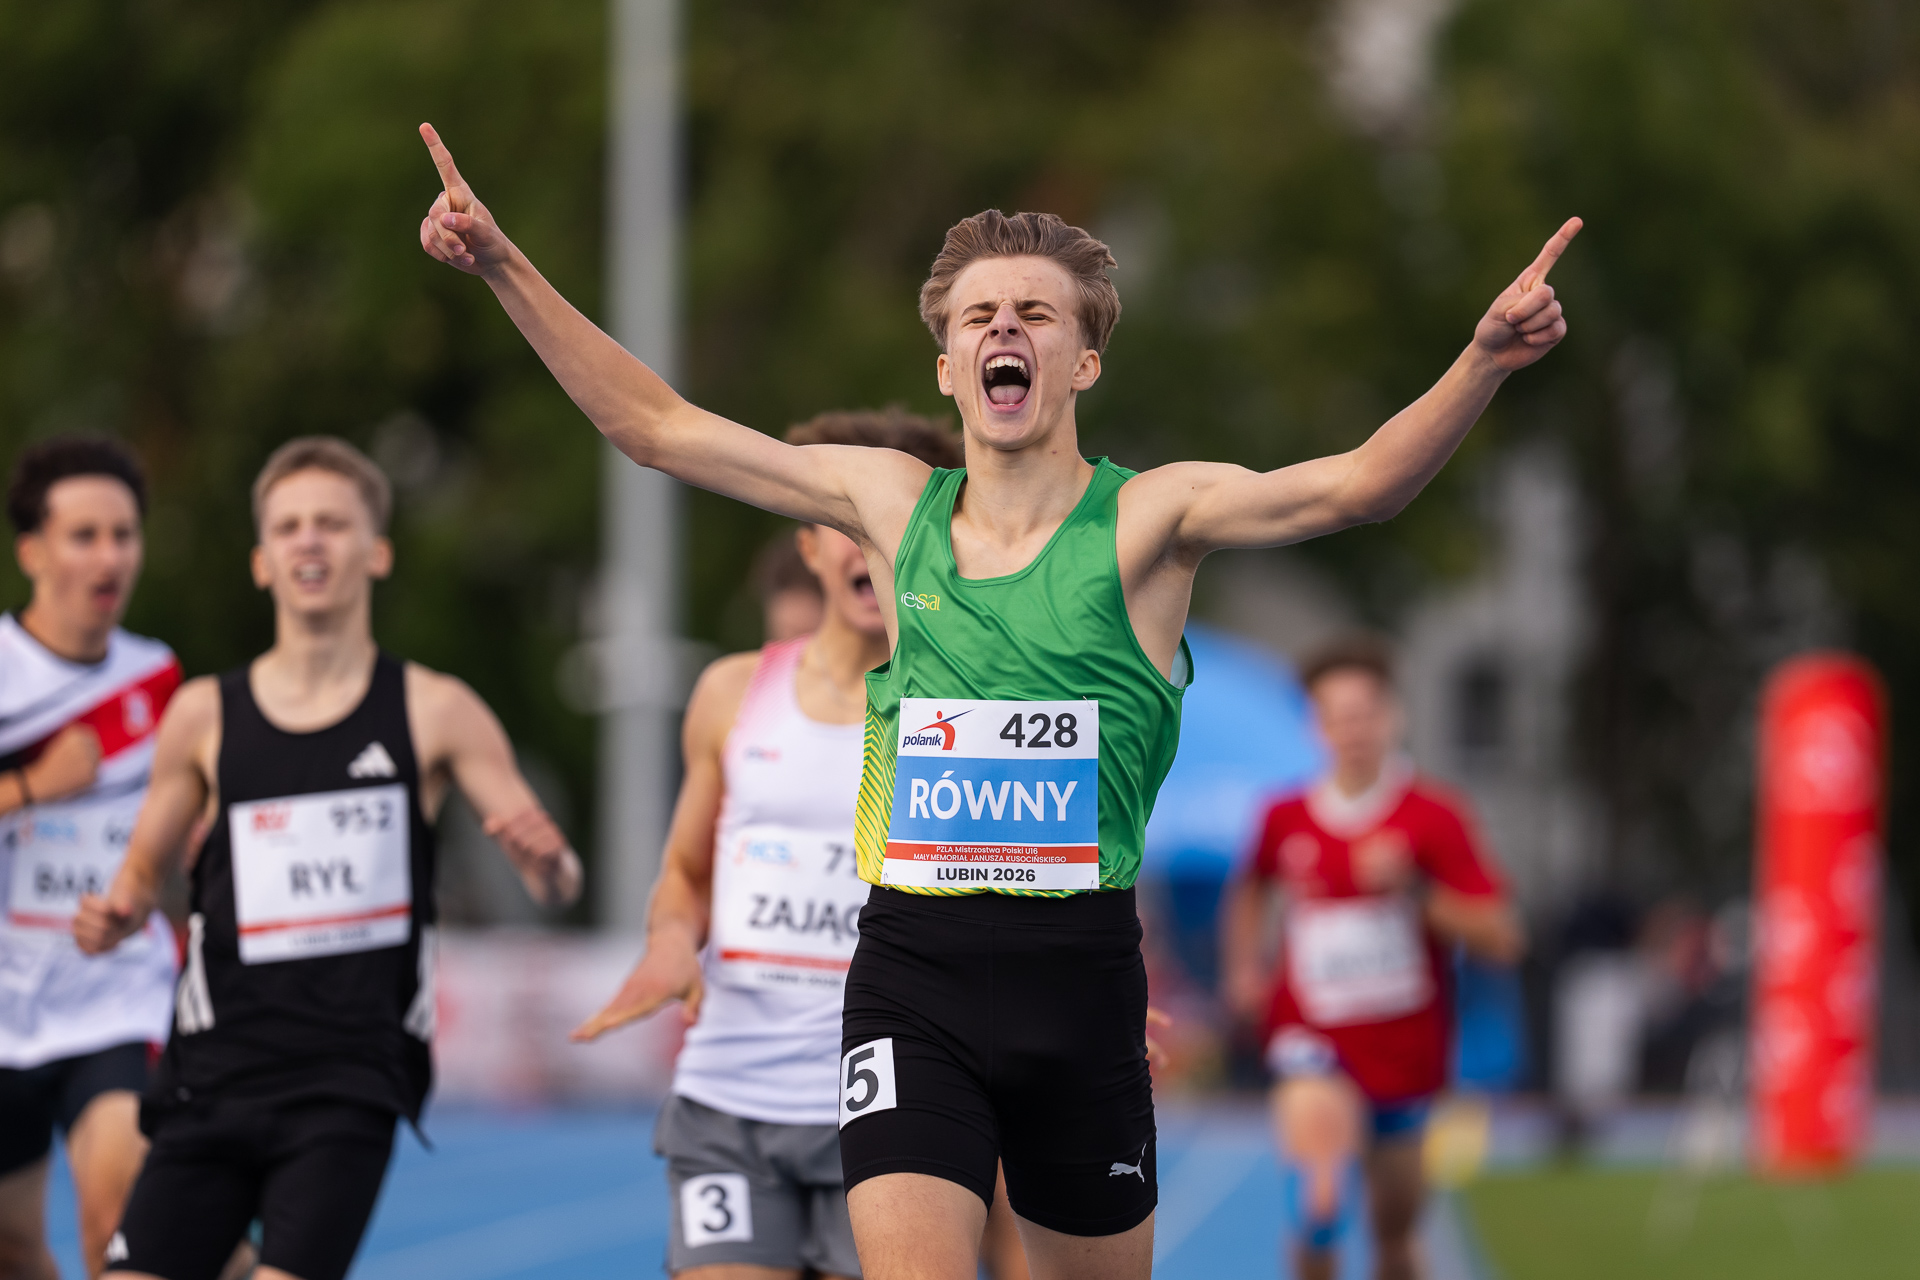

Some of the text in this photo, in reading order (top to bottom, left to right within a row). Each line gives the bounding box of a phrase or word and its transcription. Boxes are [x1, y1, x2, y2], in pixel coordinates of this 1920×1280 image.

[902, 733, 942, 748] polanik
[999, 712, 1079, 749] 428
[908, 770, 1079, 822] RÓWNY
[330, 800, 393, 835] 952
[913, 853, 1067, 864] MAŁY MEMORIAŁ JANUSZA KUSOCIŃSKIEGO
[936, 845, 1038, 855] PZLA Mistrzostwa Polski U16
[937, 867, 1036, 882] LUBIN 2026
[845, 1046, 879, 1112] 5
[700, 1183, 733, 1234] 3
